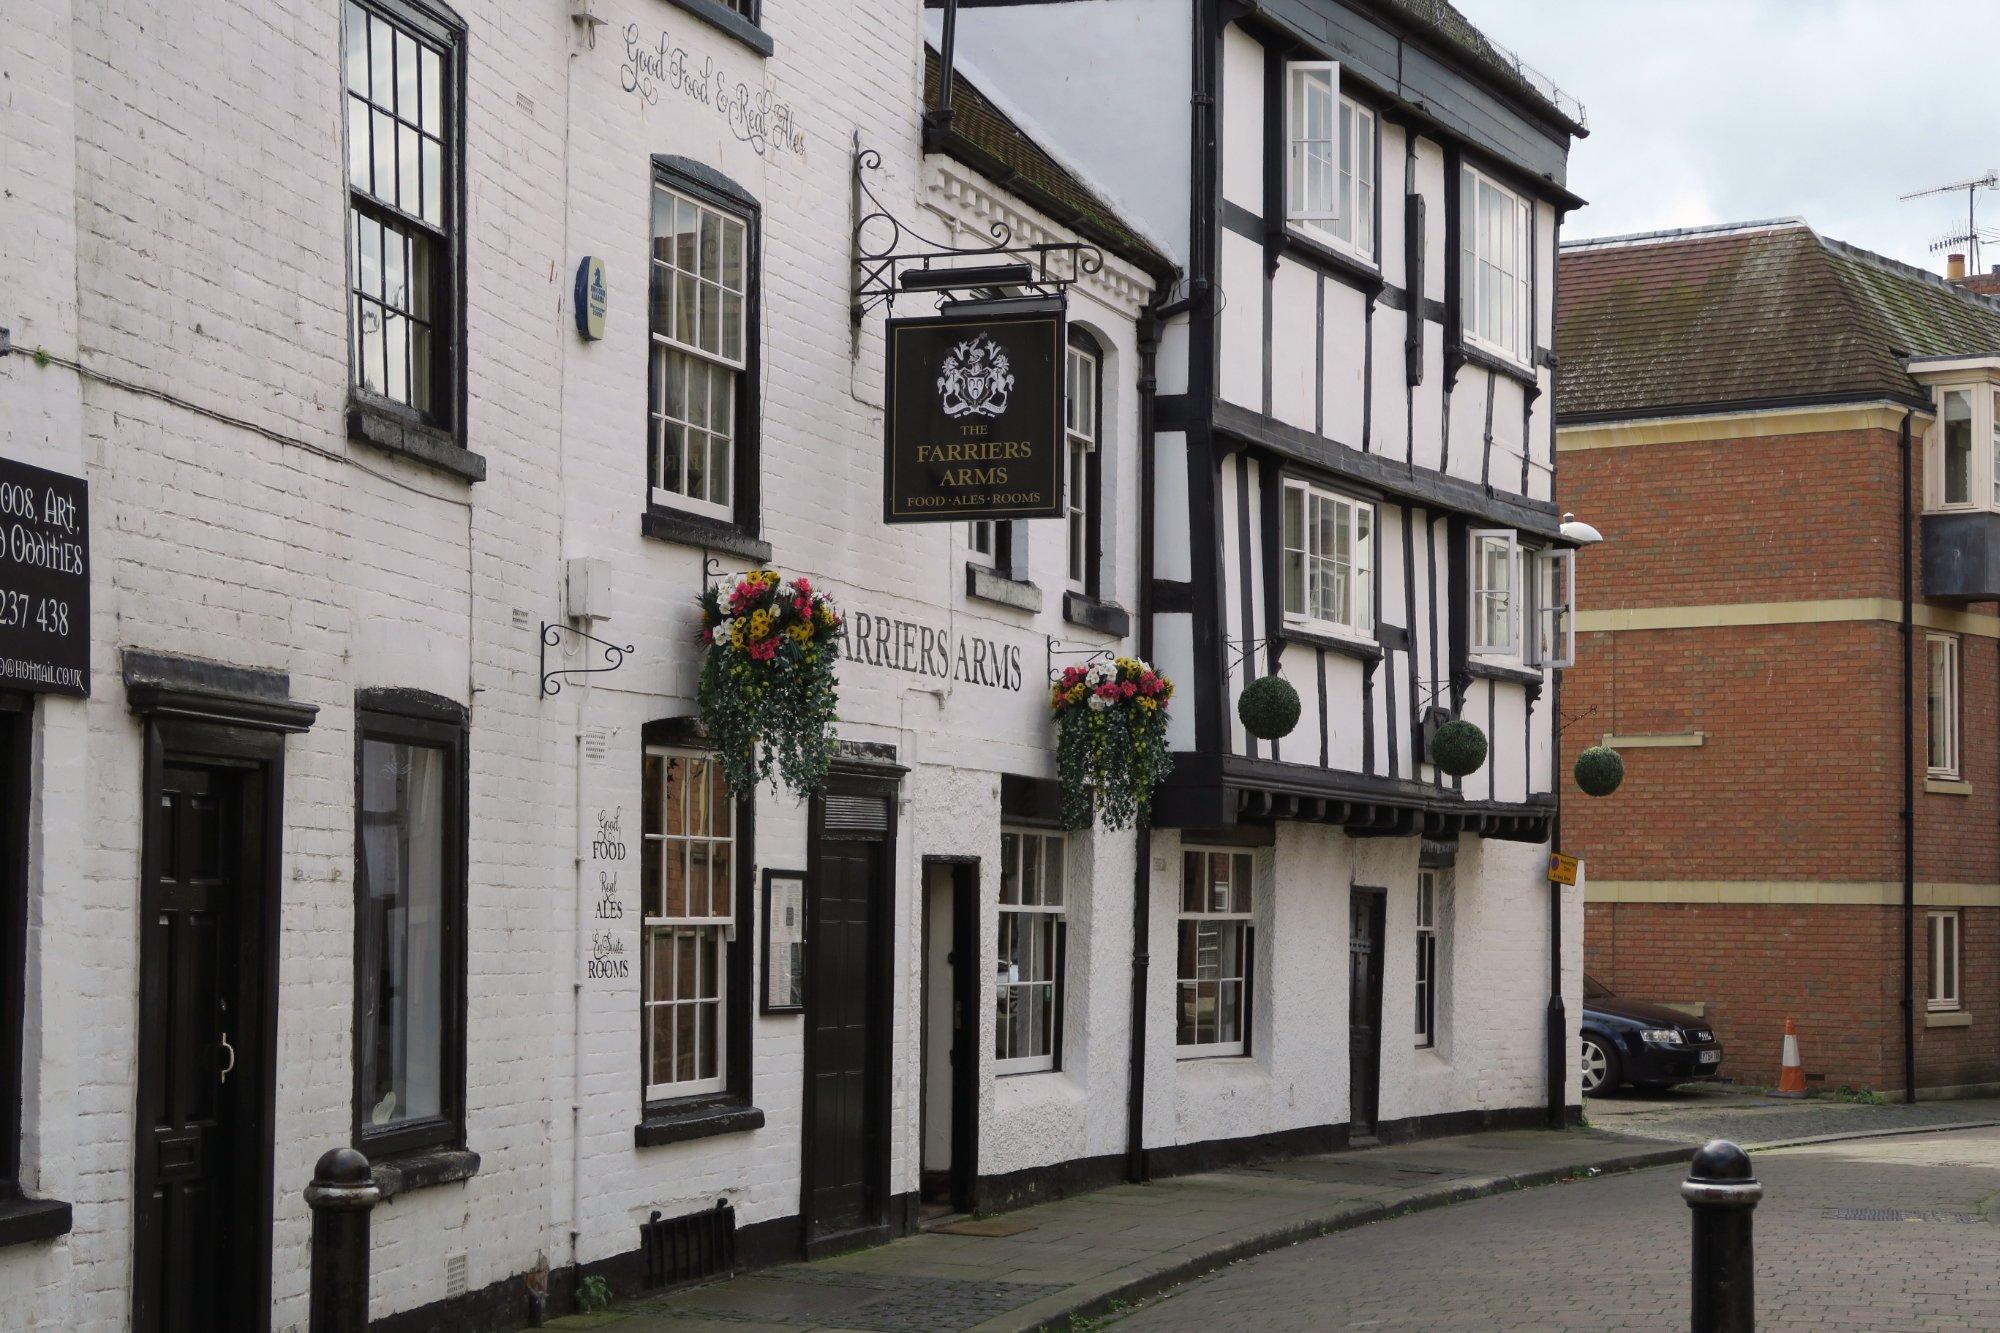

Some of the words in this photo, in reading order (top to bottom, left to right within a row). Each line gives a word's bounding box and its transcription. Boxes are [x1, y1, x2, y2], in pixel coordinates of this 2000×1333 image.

[621, 24, 669, 105] Good
[670, 48, 713, 105] Food
[729, 83, 772, 155] Real
[772, 104, 806, 155] Ales
[960, 425, 988, 435] THE
[917, 441, 1032, 463] FARRIERS
[940, 467, 1008, 486] ARMS
[907, 497, 945, 507] FOOD
[953, 494, 985, 505] ALES
[993, 492, 1041, 504] ROOMS
[36, 598, 69, 636] 438
[837, 608, 949, 679] ARRIERS
[954, 634, 1022, 692] ARMS
[597, 805, 622, 843] Good
[593, 841, 626, 860] FOOD
[600, 871, 617, 902] Real
[595, 900, 623, 919] ALES
[588, 960, 629, 978] ROOMS
